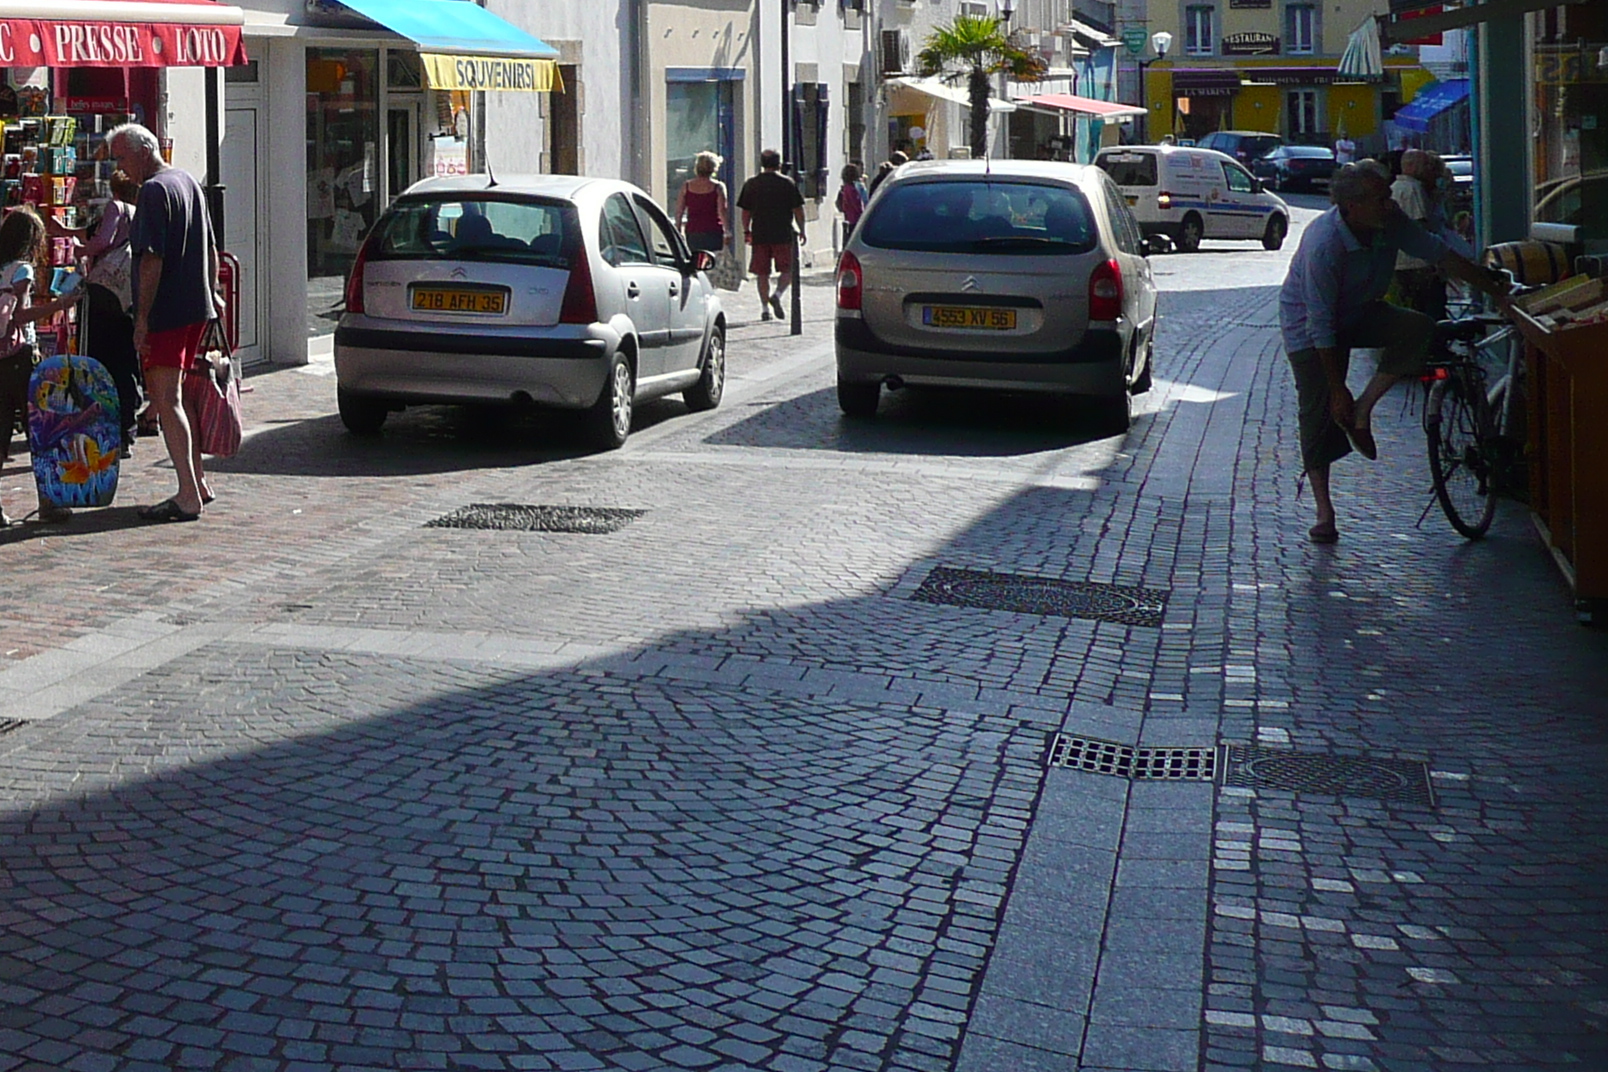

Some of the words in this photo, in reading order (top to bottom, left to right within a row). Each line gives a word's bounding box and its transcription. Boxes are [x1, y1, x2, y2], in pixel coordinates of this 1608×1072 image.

[55, 25, 142, 62] PRESSE
[176, 28, 225, 62] LOTO
[417, 292, 444, 308] 218
[449, 293, 477, 310] AFH
[482, 295, 500, 311] 35
[933, 308, 967, 325] 4553
[970, 309, 987, 325] XV
[992, 311, 1009, 326] 56
